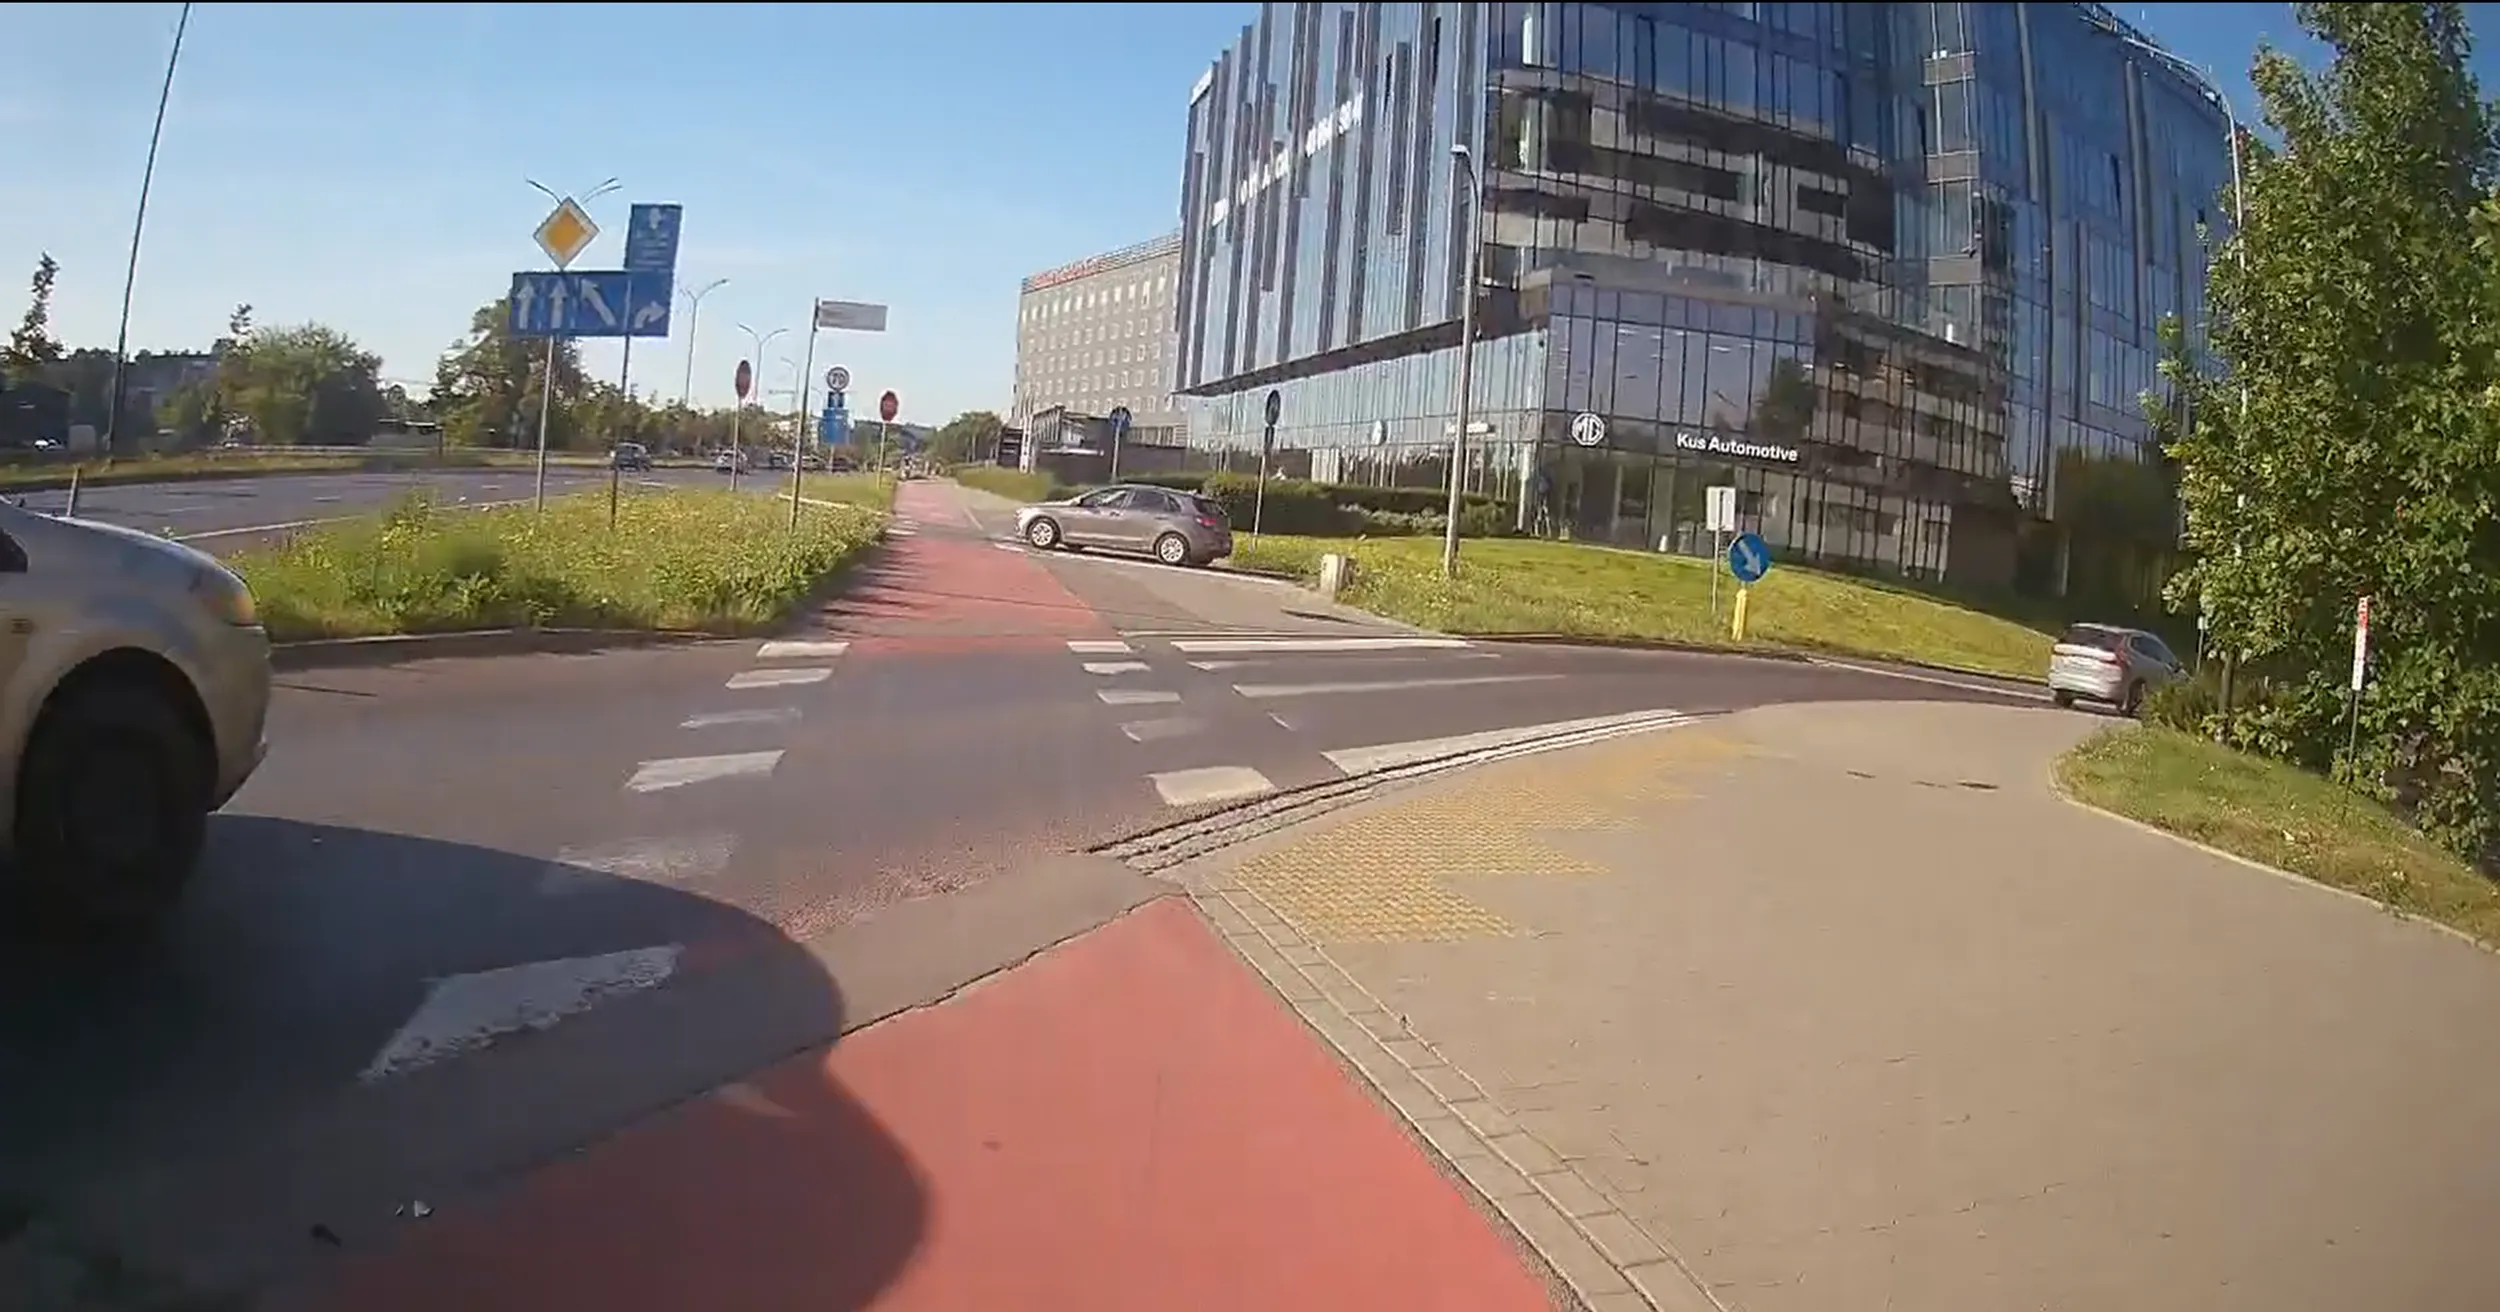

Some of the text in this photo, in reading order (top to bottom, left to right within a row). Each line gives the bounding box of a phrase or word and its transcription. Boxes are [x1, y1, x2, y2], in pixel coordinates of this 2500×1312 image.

[1574, 415, 1602, 443] MG
[1676, 432, 1798, 462] Kus Automotive
